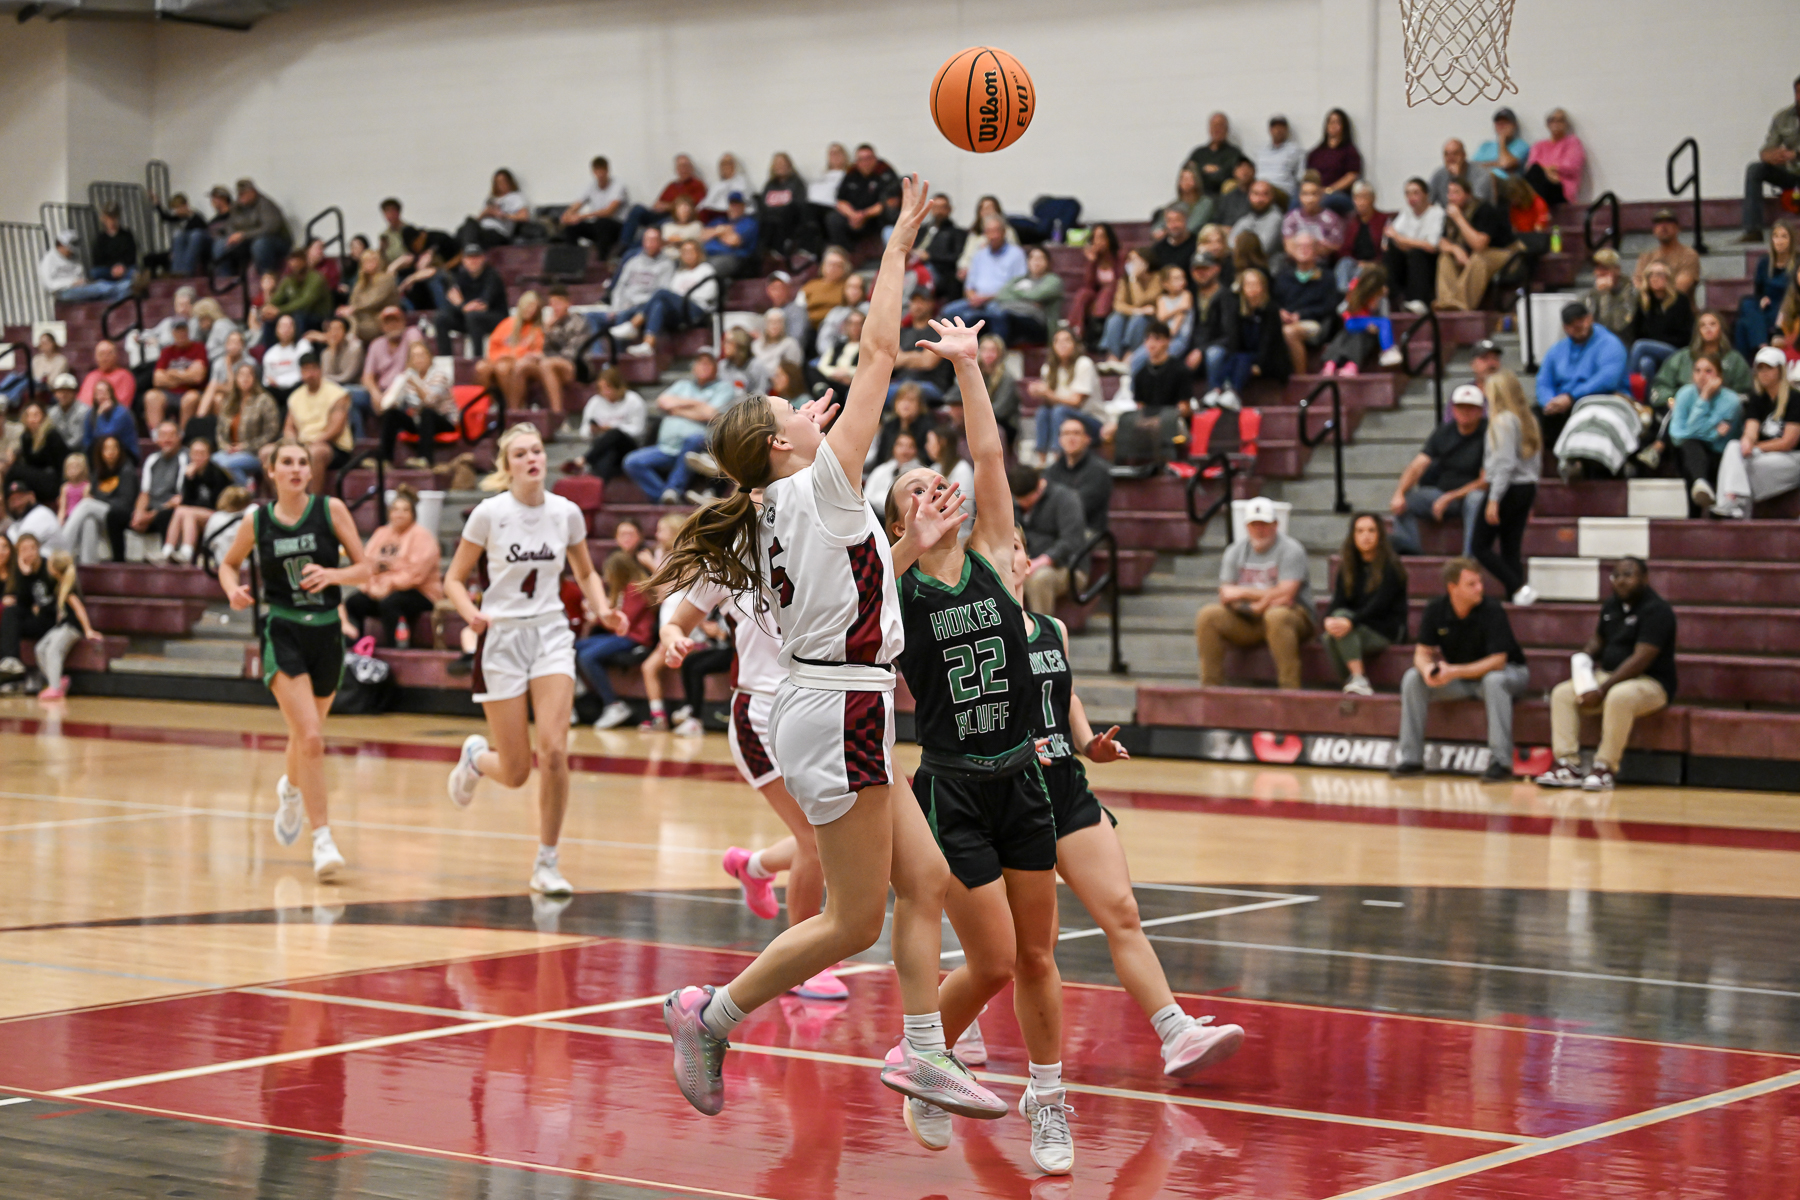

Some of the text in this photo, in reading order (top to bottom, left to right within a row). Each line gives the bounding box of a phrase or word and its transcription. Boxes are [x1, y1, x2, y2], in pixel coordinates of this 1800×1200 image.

[978, 71, 999, 142] Wilson
[520, 568, 538, 599] 4
[768, 536, 795, 608] 5
[929, 597, 1002, 641] HOKES
[943, 636, 1009, 704] 22
[1028, 649, 1067, 675] OKES
[955, 701, 1010, 741] BLUFF
[1041, 680, 1056, 728] 1
[1310, 737, 1392, 765] HOME
[1440, 745, 1492, 771] THE
